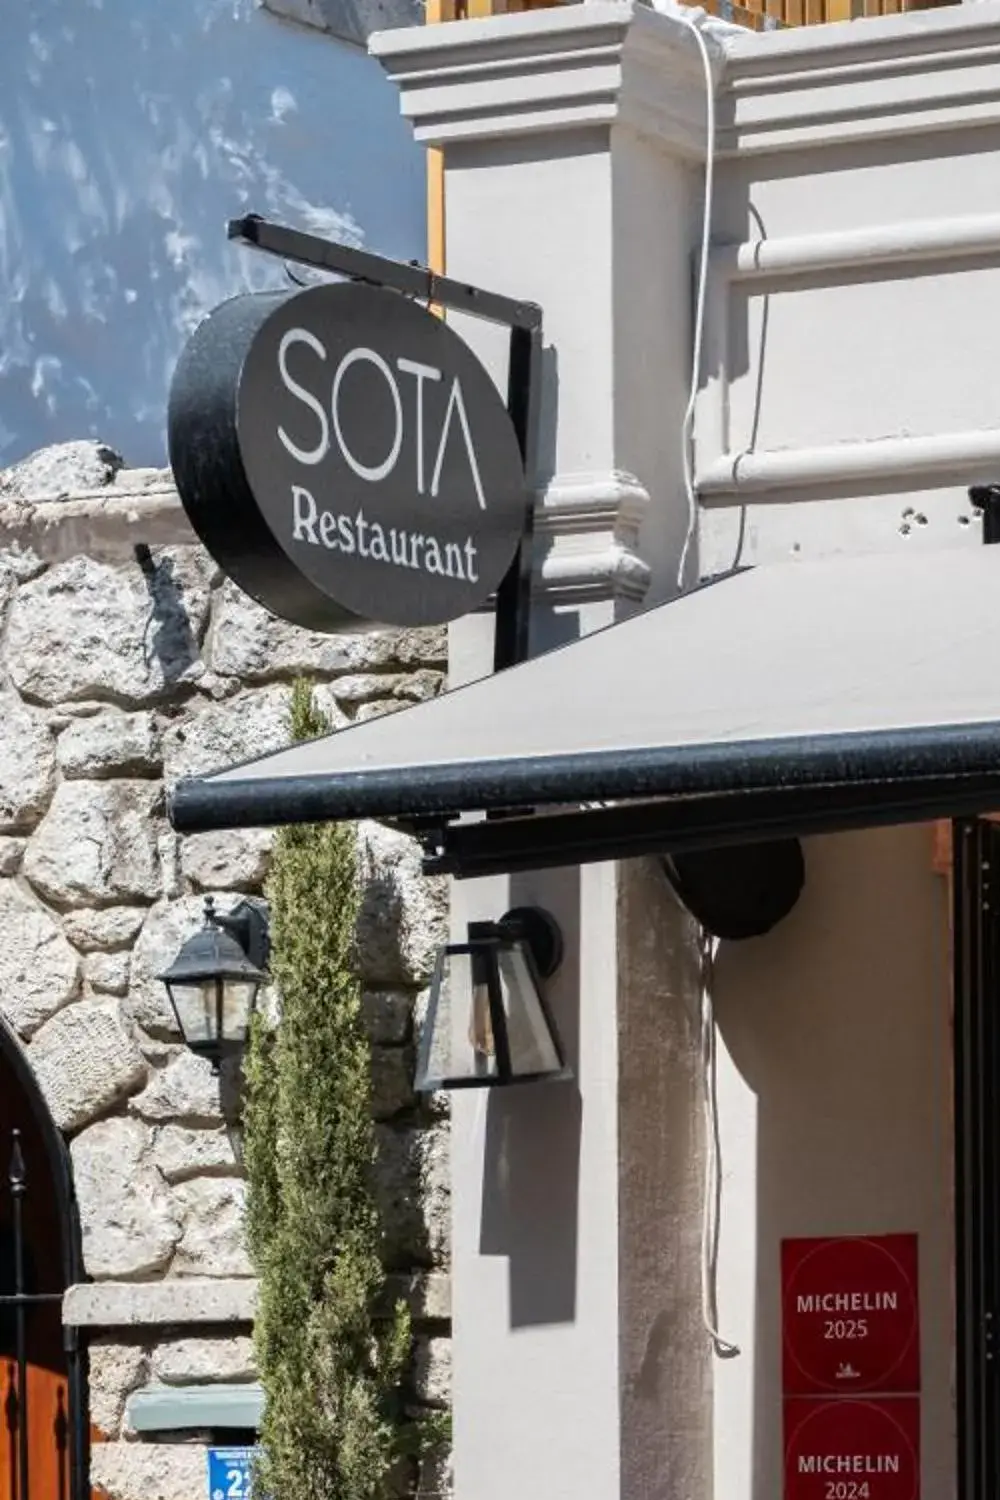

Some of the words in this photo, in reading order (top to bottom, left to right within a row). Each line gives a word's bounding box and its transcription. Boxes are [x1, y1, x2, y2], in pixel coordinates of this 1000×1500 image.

[278, 327, 488, 511] SOTA
[290, 485, 480, 583] Restaurant
[796, 1291, 898, 1313] MICHELIN
[823, 1319, 869, 1339] 2025
[797, 1455, 900, 1474] MICHELIN
[824, 1481, 870, 1500] 2024
